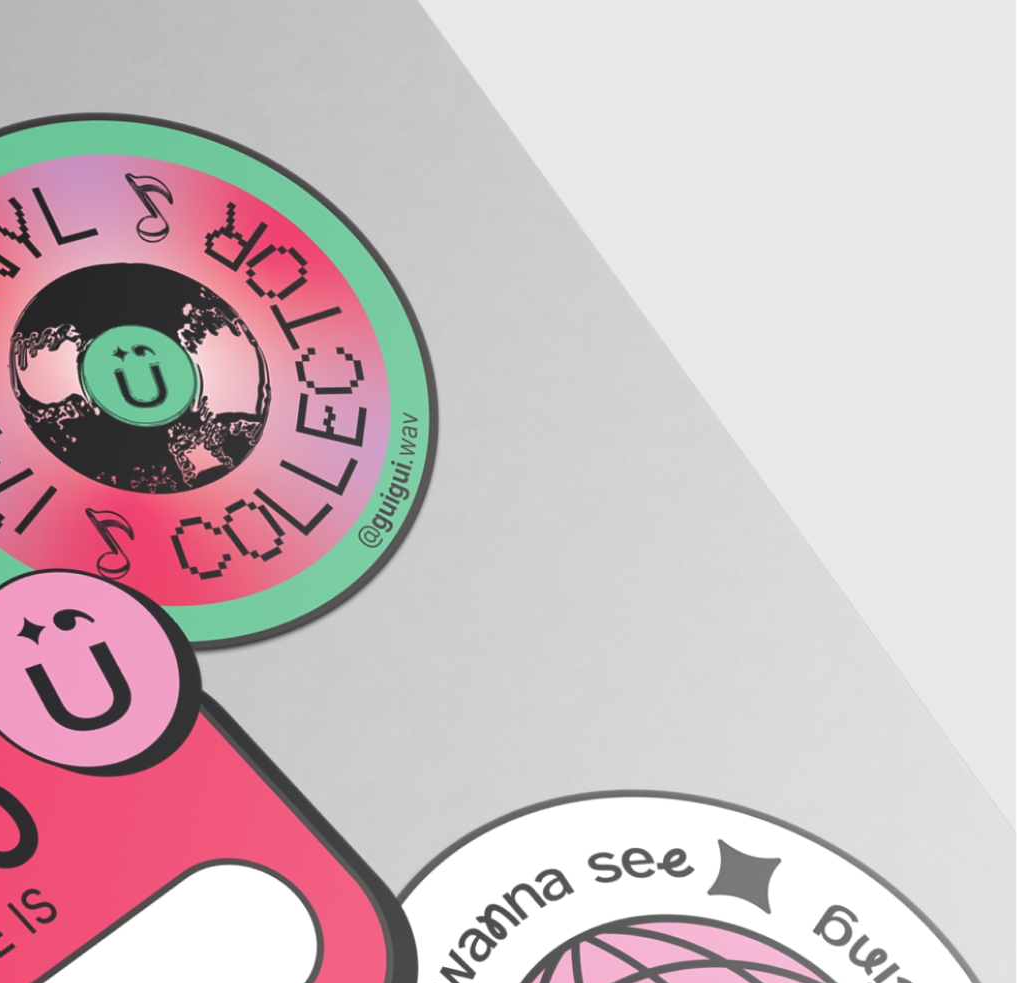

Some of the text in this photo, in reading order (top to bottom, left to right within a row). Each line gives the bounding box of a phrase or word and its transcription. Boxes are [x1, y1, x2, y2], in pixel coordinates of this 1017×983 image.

[170, 201, 368, 581] COLLECTOR
[357, 411, 419, 549] @guigui.wav
[4, 886, 60, 936] IS
[586, 846, 696, 884] see
